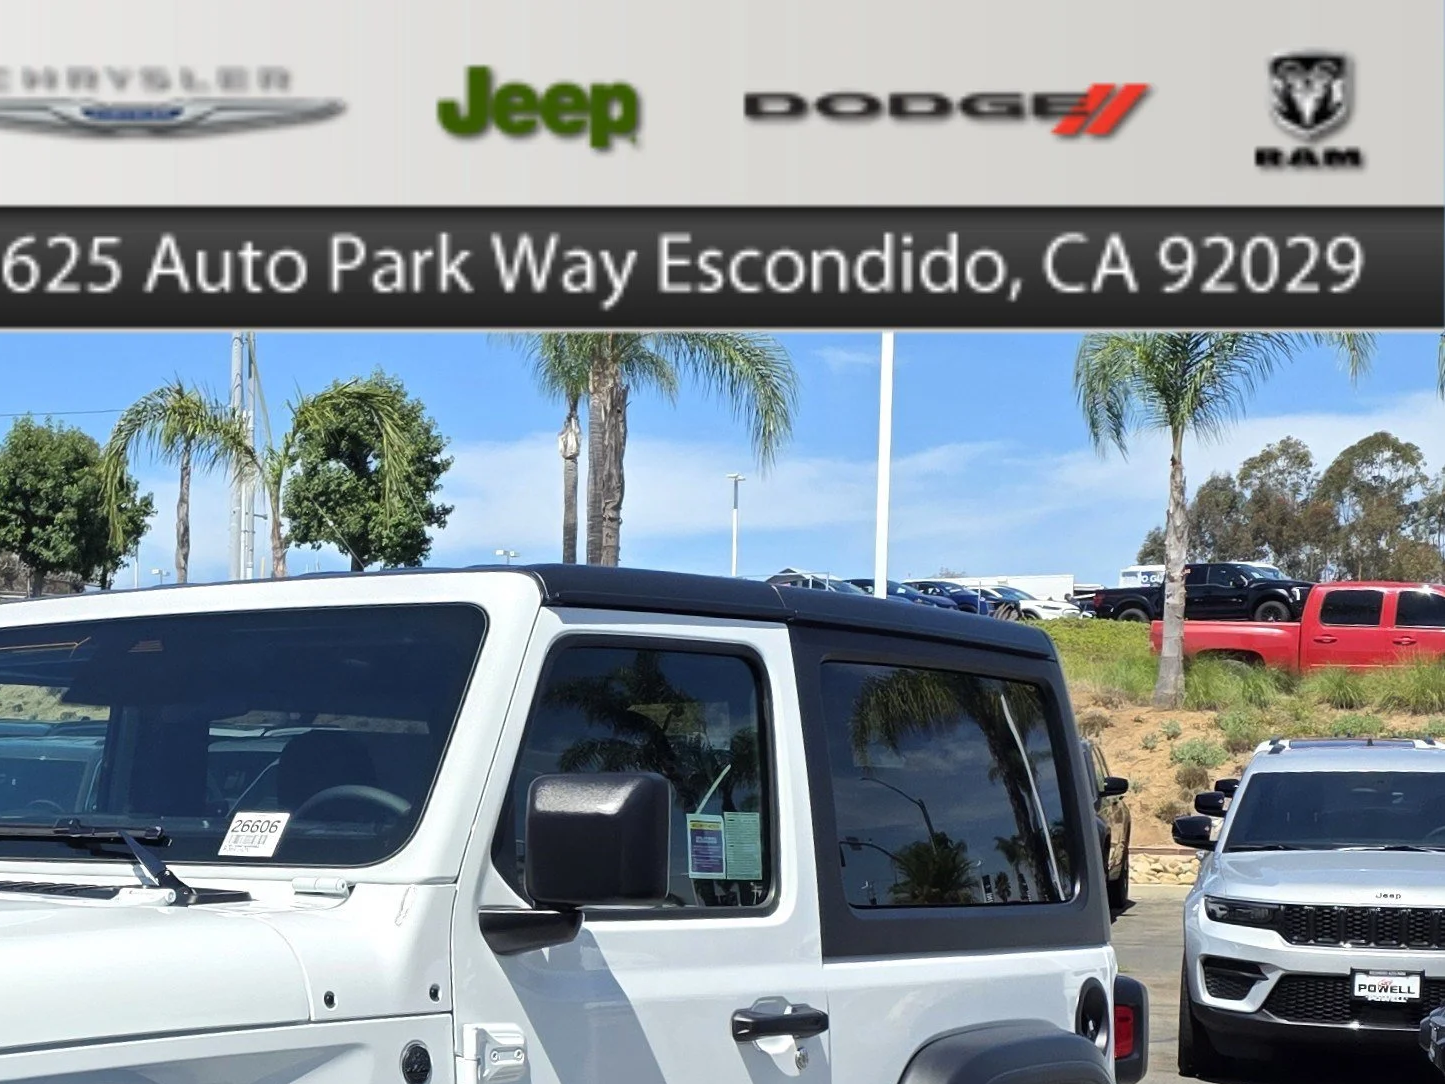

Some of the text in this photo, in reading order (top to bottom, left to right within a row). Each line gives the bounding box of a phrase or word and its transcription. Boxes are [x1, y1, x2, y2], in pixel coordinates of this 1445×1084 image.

[231, 819, 281, 834] 26606
[1375, 892, 1402, 900] Jeep
[1358, 983, 1415, 995] POWELL
